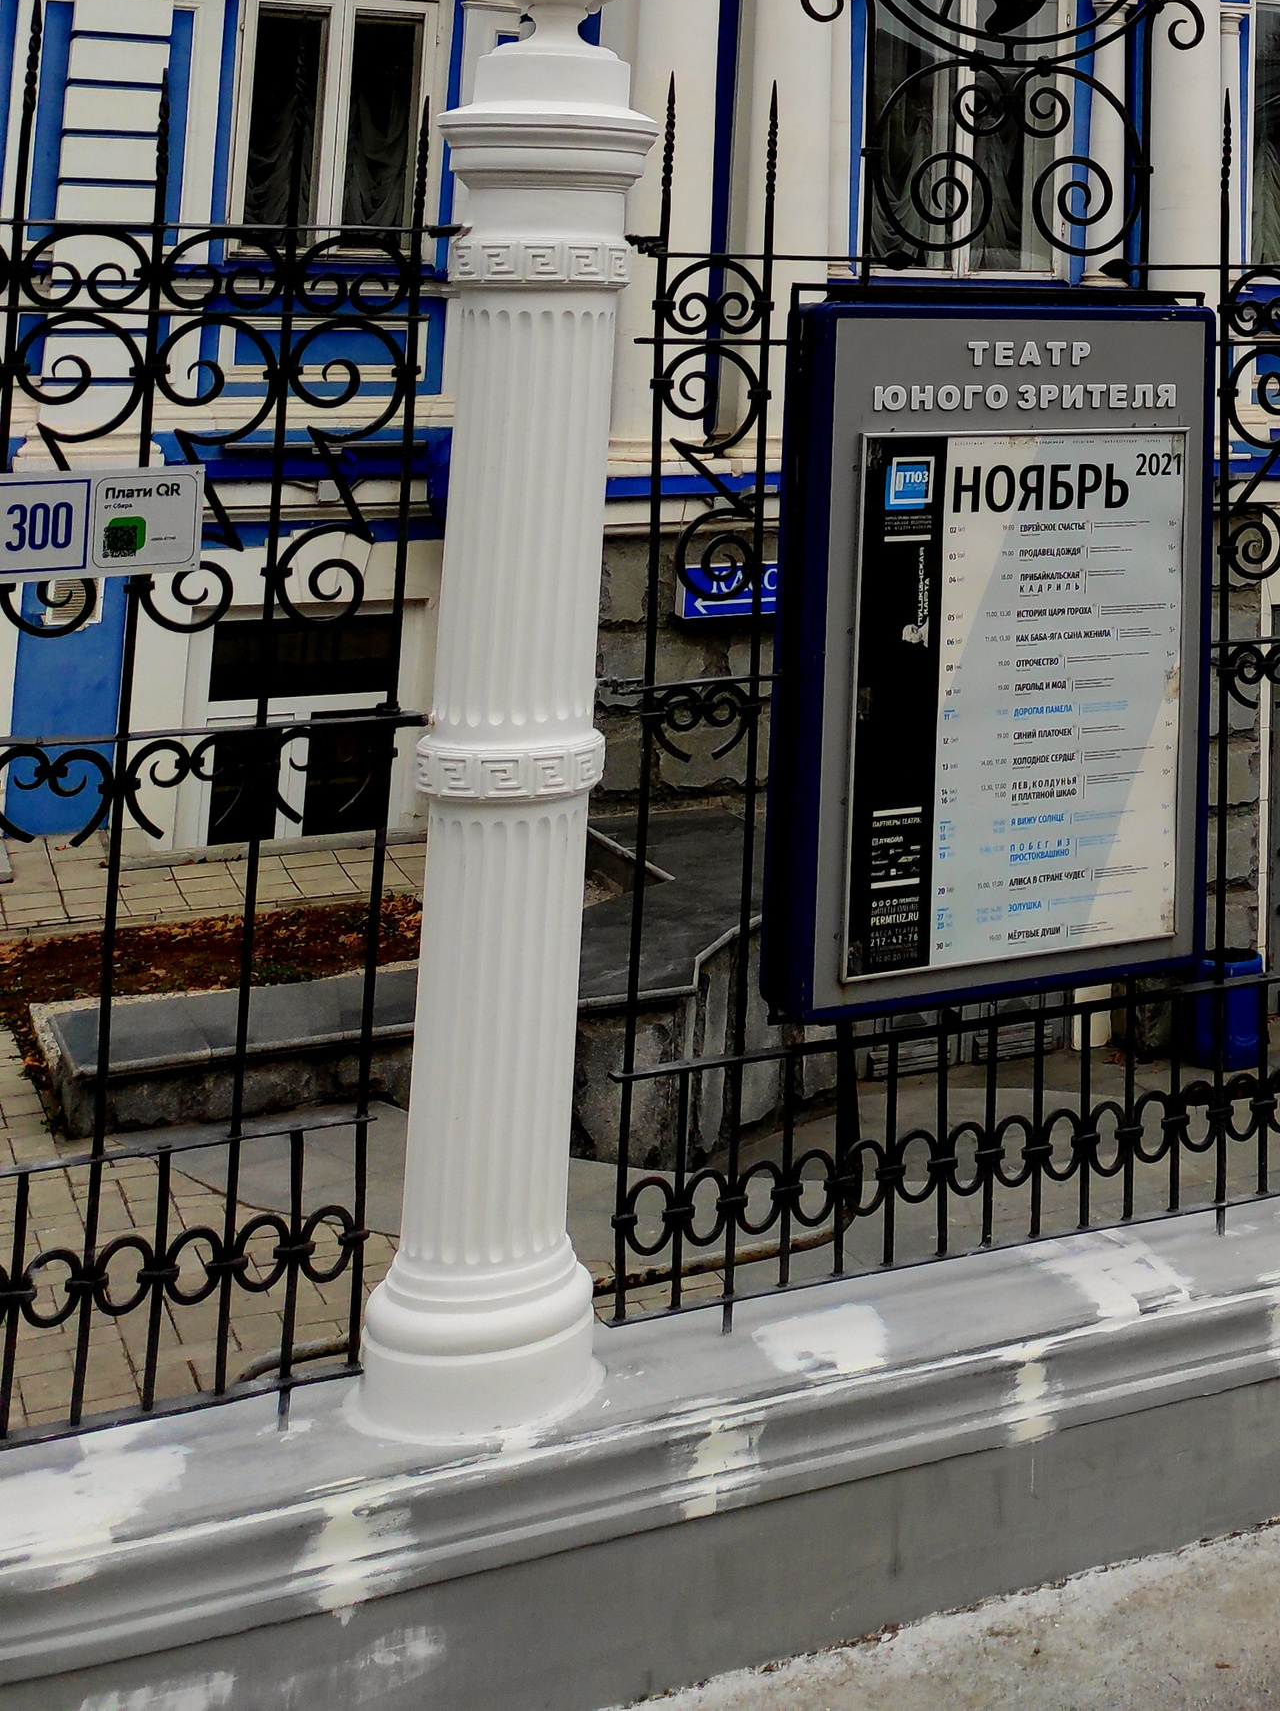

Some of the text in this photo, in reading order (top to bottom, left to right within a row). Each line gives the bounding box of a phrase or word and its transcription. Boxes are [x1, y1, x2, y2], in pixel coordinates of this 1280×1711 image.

[968, 340, 1092, 367] ТЕАТР
[873, 383, 1178, 411] ЮНОГО ЗРИТЕЛЯ
[1135, 453, 1182, 476] 2021
[105, 483, 181, 500] Плати QR
[952, 462, 1130, 514] НОЯБРЬ
[5, 501, 73, 552] 300
[1020, 522, 1057, 532] ЕВРЕЙСКОЕ
[1058, 522, 1086, 531] СЧАСТЬЕ
[1019, 548, 1055, 558] ПРОДАВЕЦ
[1056, 547, 1081, 557] ДОЖДЯ
[1020, 571, 1080, 581] ПРИБАЙКАЛЬСКАЯ
[917, 546, 925, 626] ПУШКИНСКАЯ
[1016, 608, 1047, 618] ИСТОРИЯ
[1048, 607, 1067, 617] ЦАРЯ
[1067, 606, 1092, 616] ГОРОХА
[1016, 634, 1029, 643] КАК
[1030, 631, 1063, 641] БАБА-ЯГА
[1063, 630, 1082, 640] СЫНА
[1083, 629, 1111, 638] ЖЕНИЛА
[1016, 657, 1060, 668] ОТРОЧЕСТВО
[1014, 682, 1044, 692] ГАРОЛЬД
[1045, 681, 1051, 690] И
[1051, 680, 1067, 690] МОД
[1013, 706, 1044, 718] ДОРОГАЯ
[1045, 704, 1073, 714] ПАМЕЛА
[1013, 729, 1037, 740] СИНИЙ
[1037, 727, 1073, 738] ПЛАТОЧЕК
[1012, 754, 1050, 766] ХОЛОДНОЕ
[1050, 752, 1076, 763] СЕРДЦЕ
[1011, 781, 1031, 791] ЛЕВ,
[1032, 776, 1077, 788] КОЛДУНЬЯ
[1011, 793, 1017, 802] И
[1018, 790, 1055, 801] ПЛАТЯНОЙ
[1055, 788, 1077, 798] ШКАФ
[1010, 818, 1016, 826] Я
[1017, 816, 1037, 826] ВИЖУ
[1038, 813, 1065, 823] СОЛНЦЕ
[1010, 840, 1050, 852] ПОБЕГ
[1057, 838, 1071, 847] ИЗ
[1010, 847, 1071, 863] ПРОСТОКВАШИНО
[1008, 877, 1031, 887] АЛИСА
[1032, 876, 1038, 884] В
[1038, 872, 1063, 883] СТРАНЕ
[1064, 870, 1086, 880] ЧУДЕС
[1008, 900, 1042, 912] ЗОЛУШКА
[870, 911, 919, 927] PERMTUZ.RU
[1007, 929, 1040, 941] МЁРТВЫЕ
[1040, 926, 1061, 937] ДУШИ
